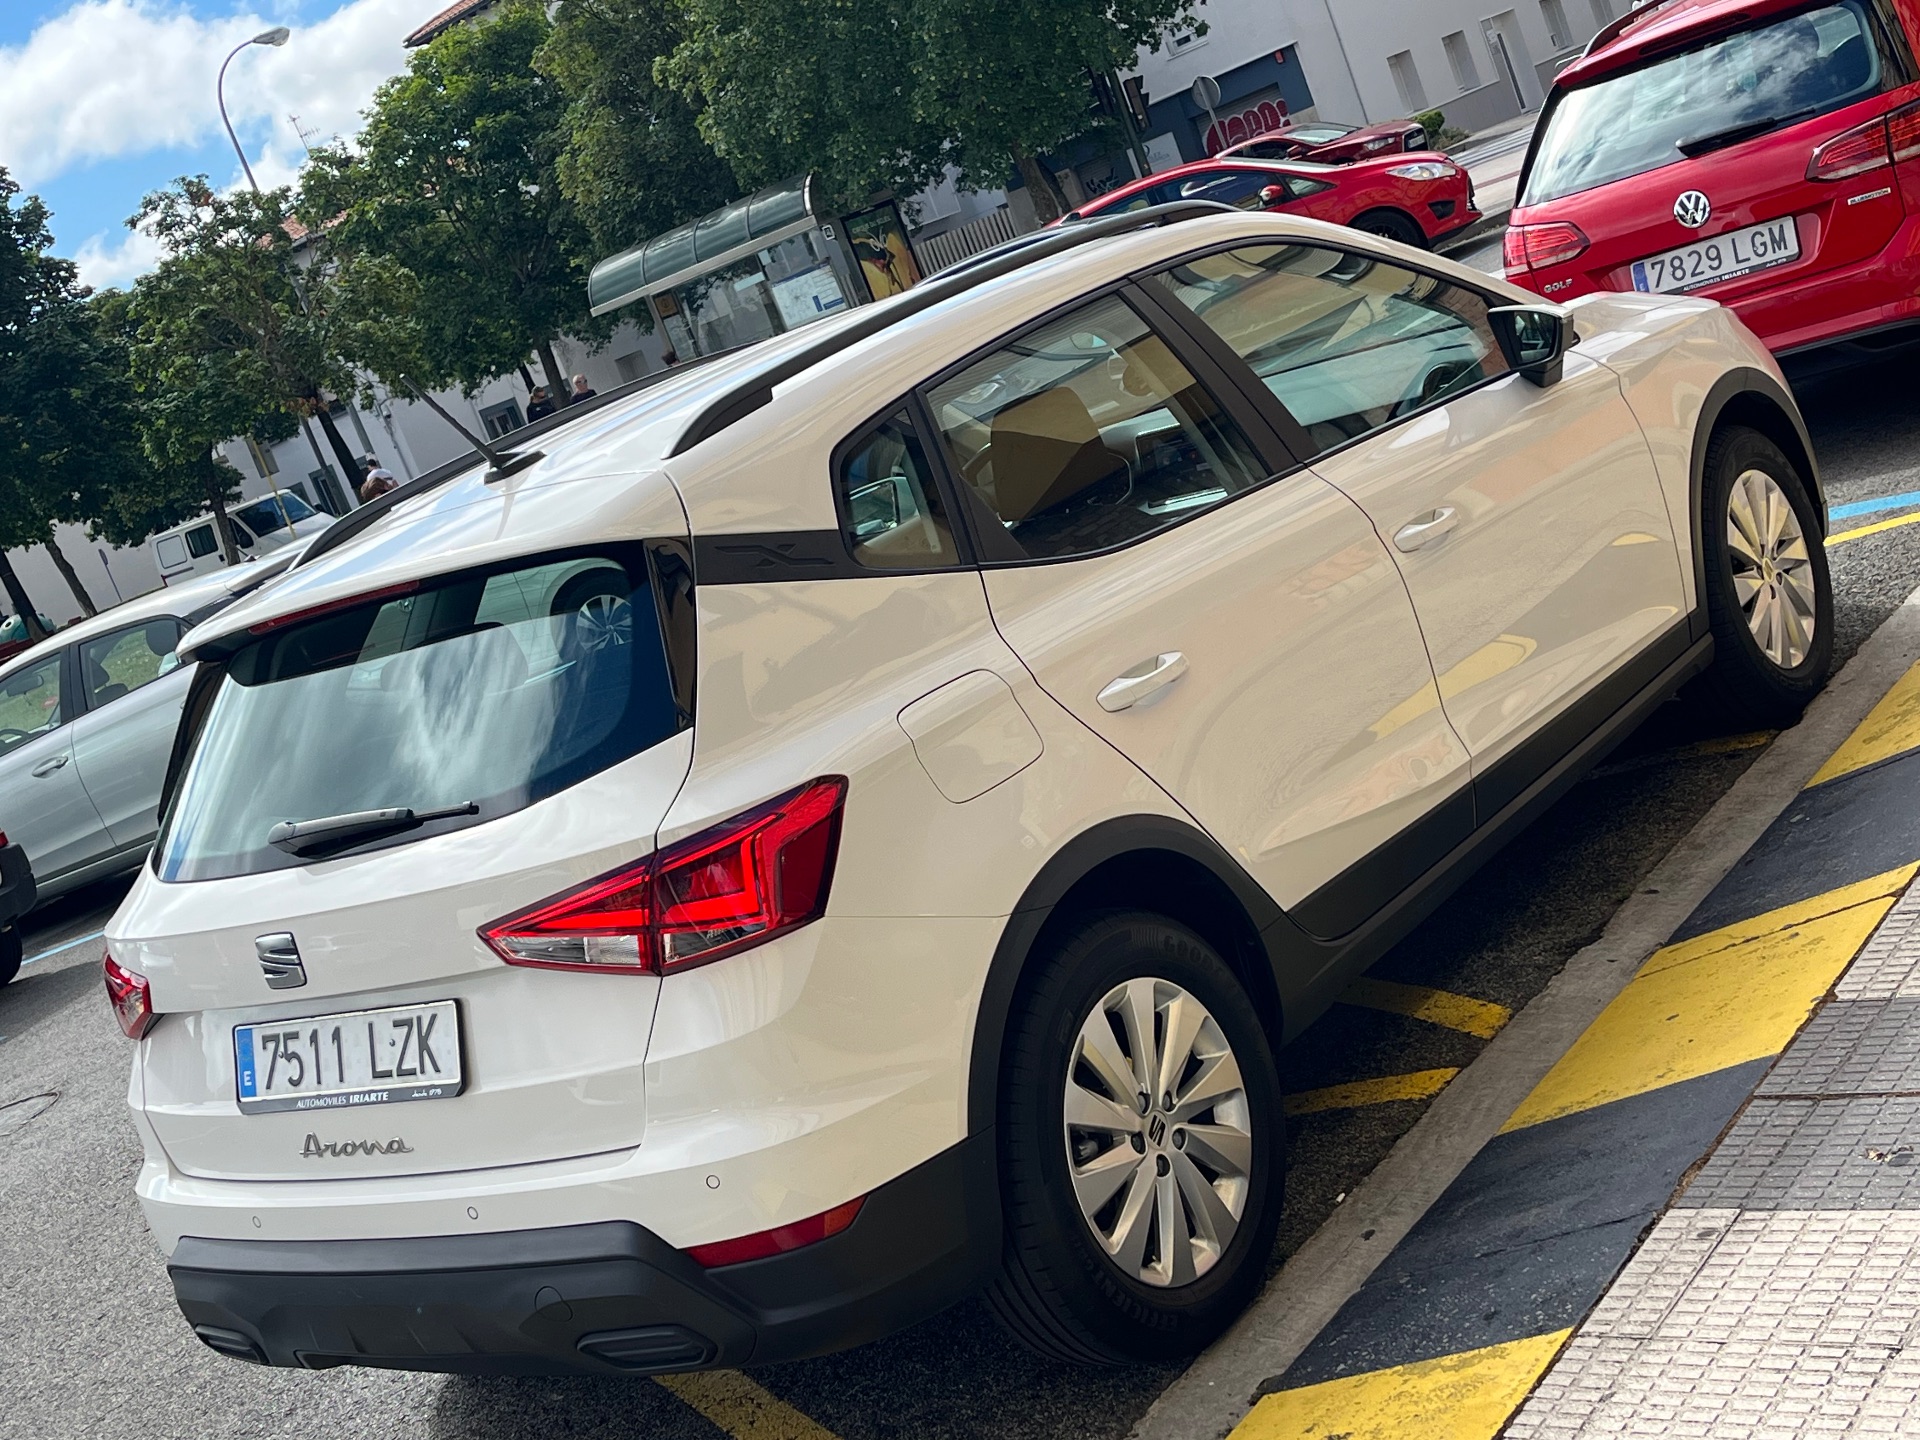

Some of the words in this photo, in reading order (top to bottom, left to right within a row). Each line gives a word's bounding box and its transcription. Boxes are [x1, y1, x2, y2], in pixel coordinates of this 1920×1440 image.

[1651, 244, 1723, 288] 7829
[1731, 224, 1788, 264] LGM
[1544, 278, 1573, 293] GOLF
[243, 1070, 252, 1087] E
[261, 1026, 345, 1090] 7511
[368, 1013, 441, 1079] LZK
[350, 1091, 389, 1104] IRIARTE
[299, 1131, 414, 1158] Arona
